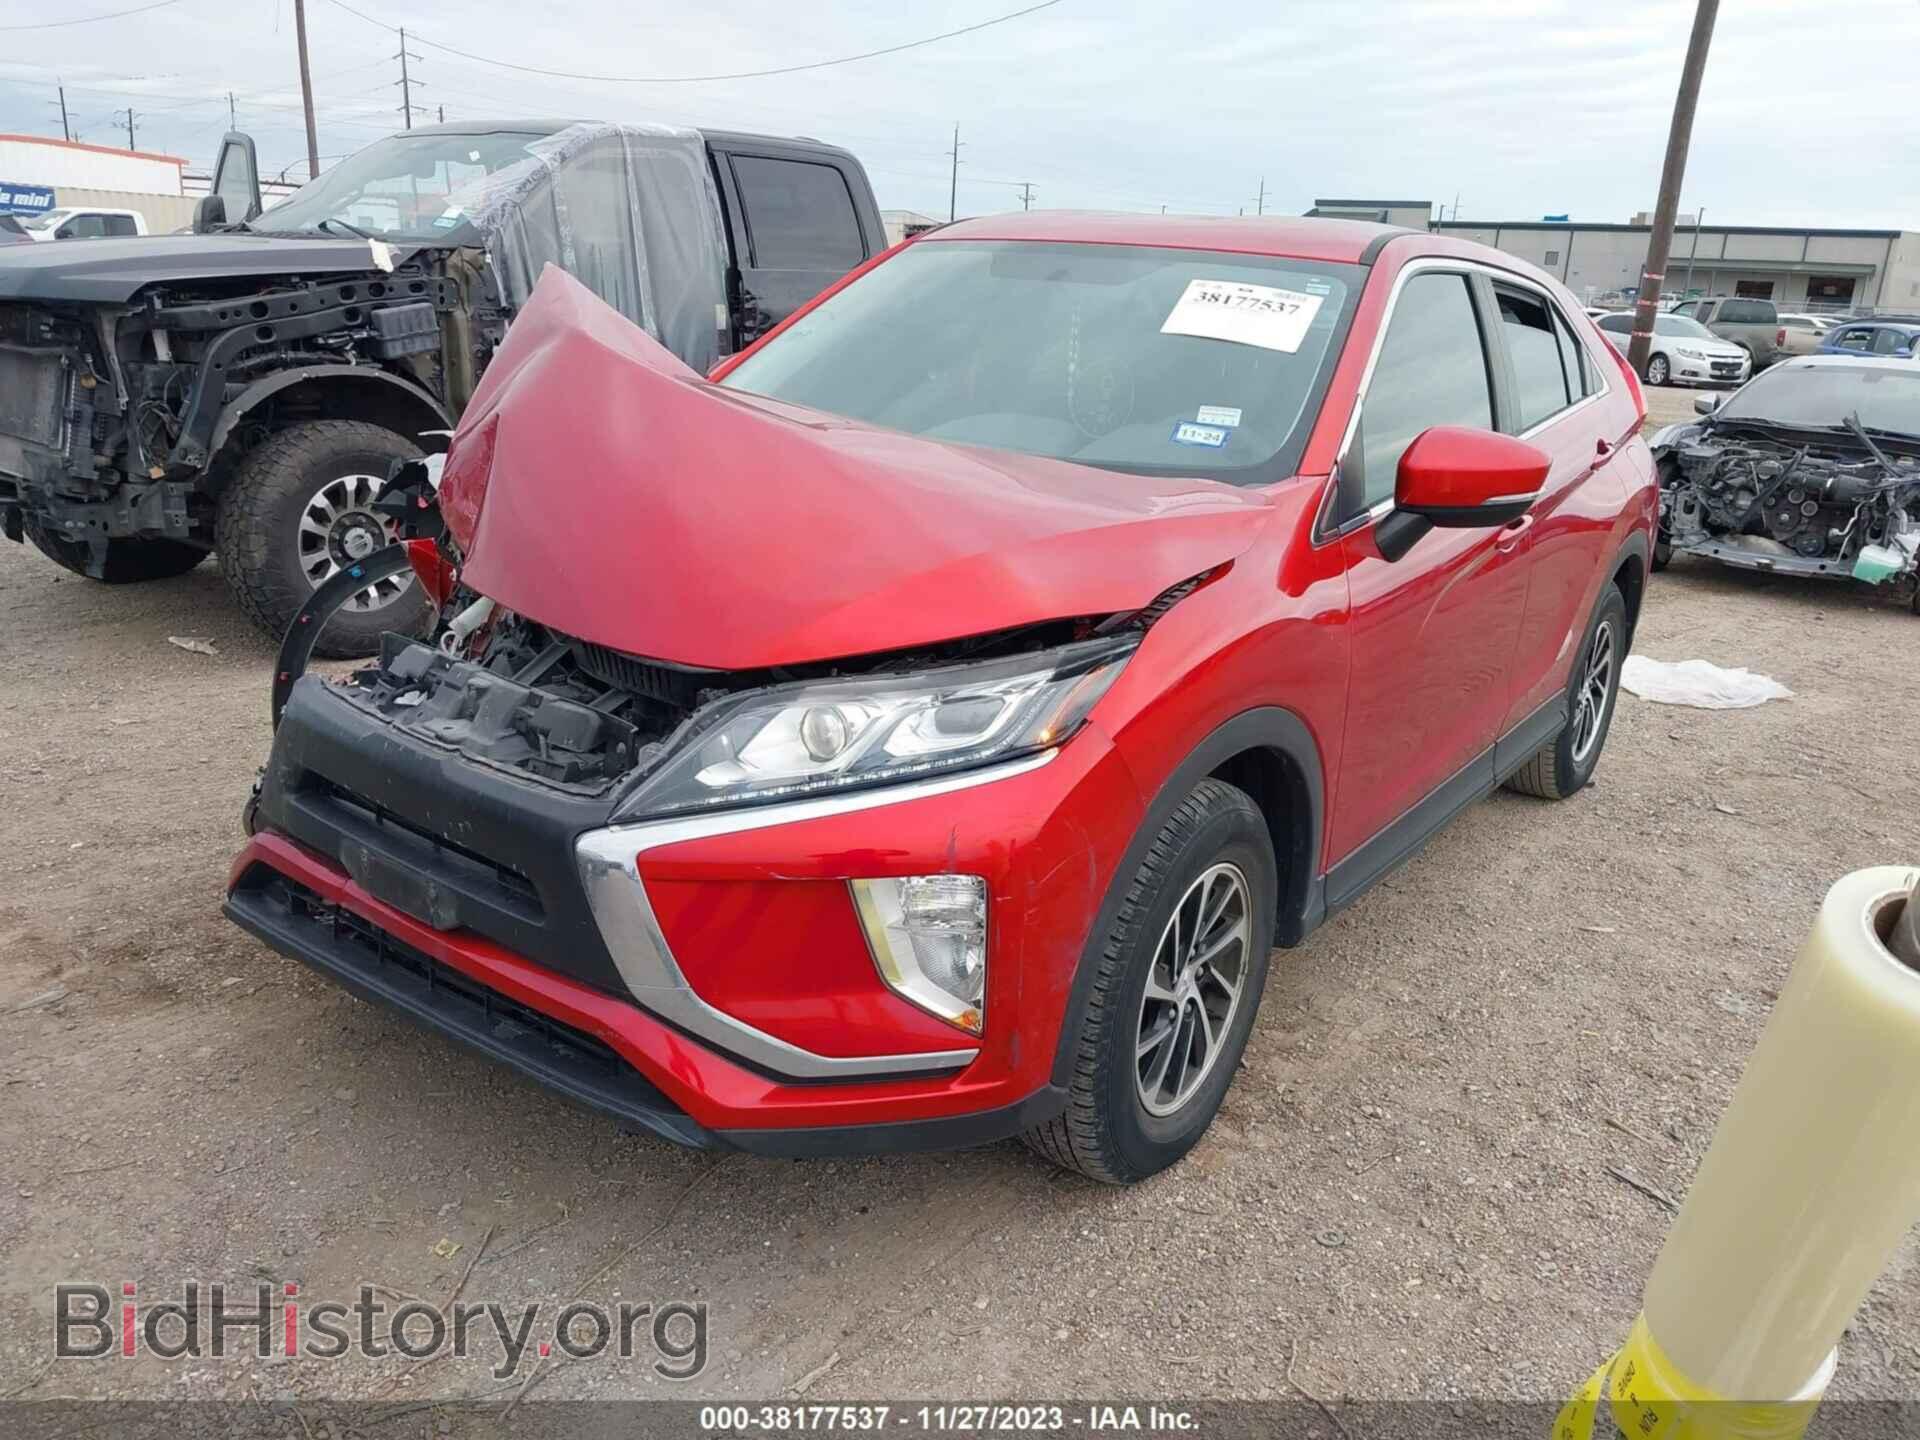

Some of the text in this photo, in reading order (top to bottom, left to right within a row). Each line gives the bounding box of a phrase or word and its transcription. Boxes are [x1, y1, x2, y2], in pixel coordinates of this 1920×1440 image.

[13, 192, 52, 207] mini
[1193, 291, 1300, 315] 38177537
[1183, 429, 1220, 442] 11-24
